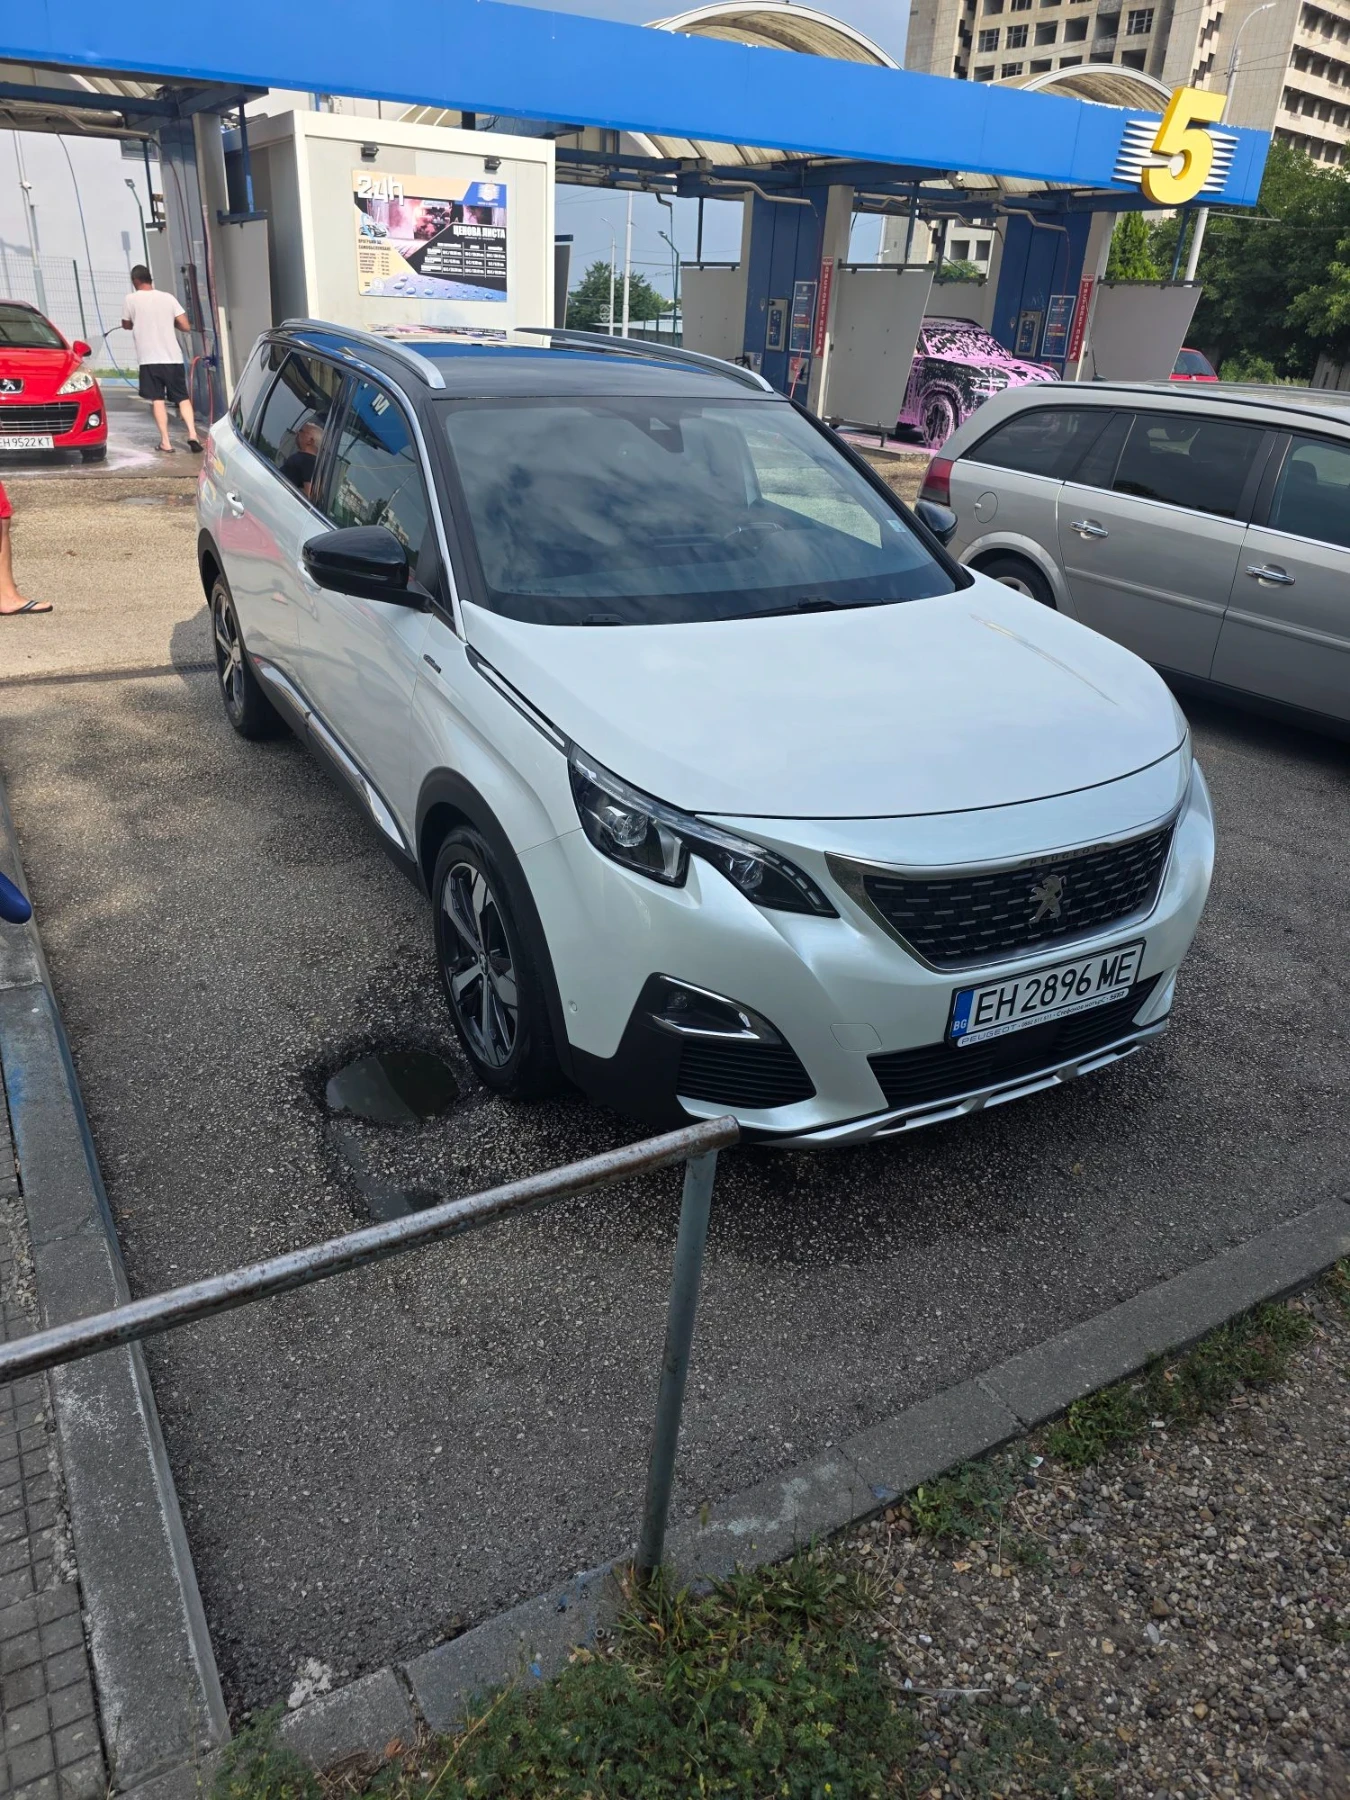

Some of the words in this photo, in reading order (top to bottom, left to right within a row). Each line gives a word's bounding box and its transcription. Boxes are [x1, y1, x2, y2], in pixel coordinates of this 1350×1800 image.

[1141, 86, 1227, 205] 5
[357, 175, 404, 206] 24h
[453, 224, 481, 237] ЦЕНОВА
[482, 227, 506, 239] ЛИСТА
[820, 266, 830, 317] ПИСТОЛЕТ
[1078, 282, 1089, 327] ПИСТОЛЕТ
[12, 437, 36, 447] 9522
[38, 437, 51, 447] KT
[1029, 844, 1100, 866] PEUGEOT
[974, 983, 1019, 1026] EH
[1020, 963, 1092, 1013] 2896
[1096, 950, 1137, 991] ME
[953, 1018, 968, 1031] BG
[961, 1023, 1018, 1045] PEUGEOT
